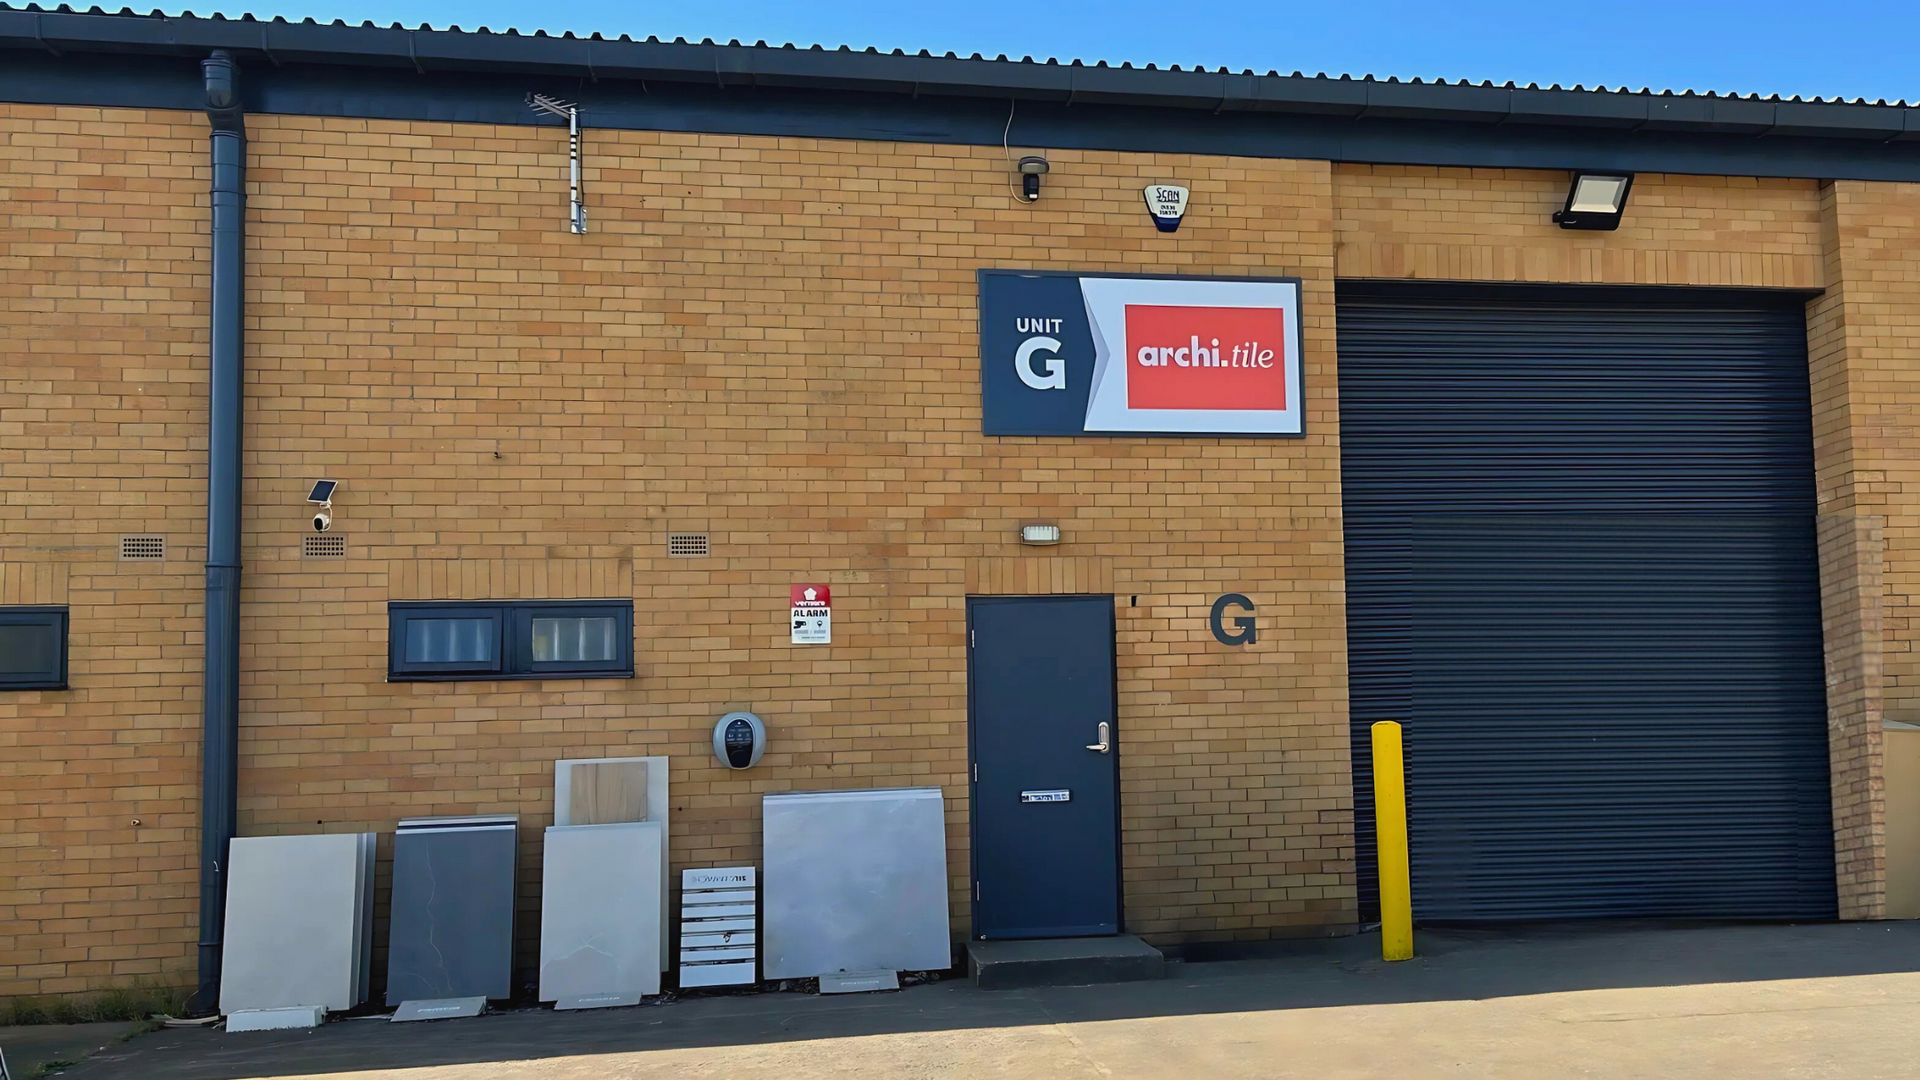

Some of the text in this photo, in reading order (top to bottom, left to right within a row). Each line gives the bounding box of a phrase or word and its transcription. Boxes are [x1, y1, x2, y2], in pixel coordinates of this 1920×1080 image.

[1016, 317, 1063, 333] UNIT
[1015, 336, 1066, 390] G
[1137, 335, 1275, 368] archi.tile
[793, 609, 828, 617] ALARM
[1210, 593, 1256, 646] G
